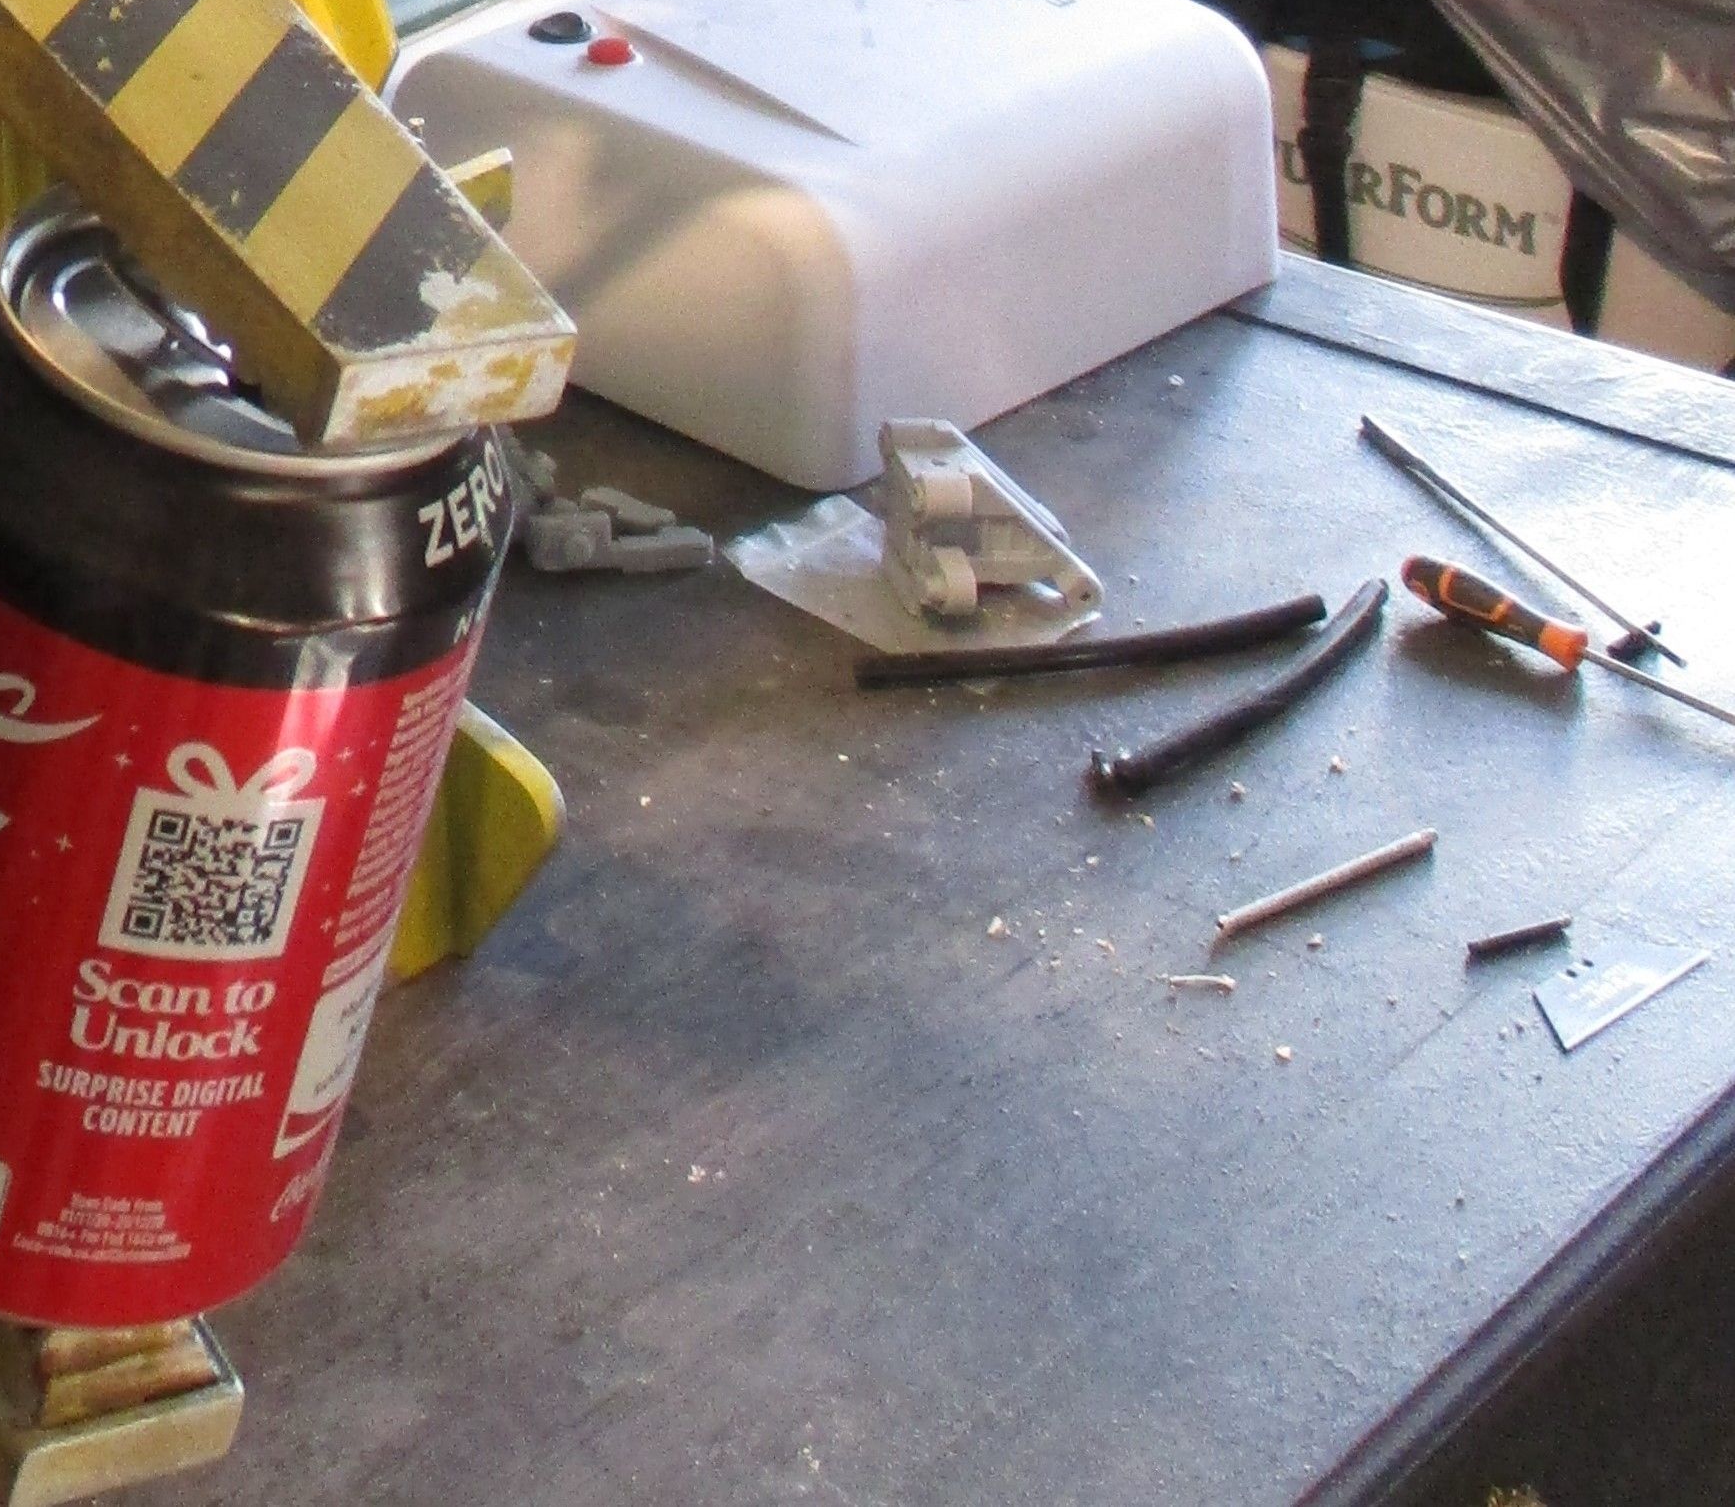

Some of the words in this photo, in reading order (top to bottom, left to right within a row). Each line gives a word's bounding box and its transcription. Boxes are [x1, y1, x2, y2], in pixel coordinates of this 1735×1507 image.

[417, 440, 504, 568] ZERO
[73, 958, 212, 1017] Scan
[225, 979, 277, 1015] to
[69, 1004, 263, 1061] Unlock
[37, 1060, 169, 1106] SURPRISE
[171, 1072, 265, 1107] DIGITAL
[83, 1104, 203, 1137] CONTENT
